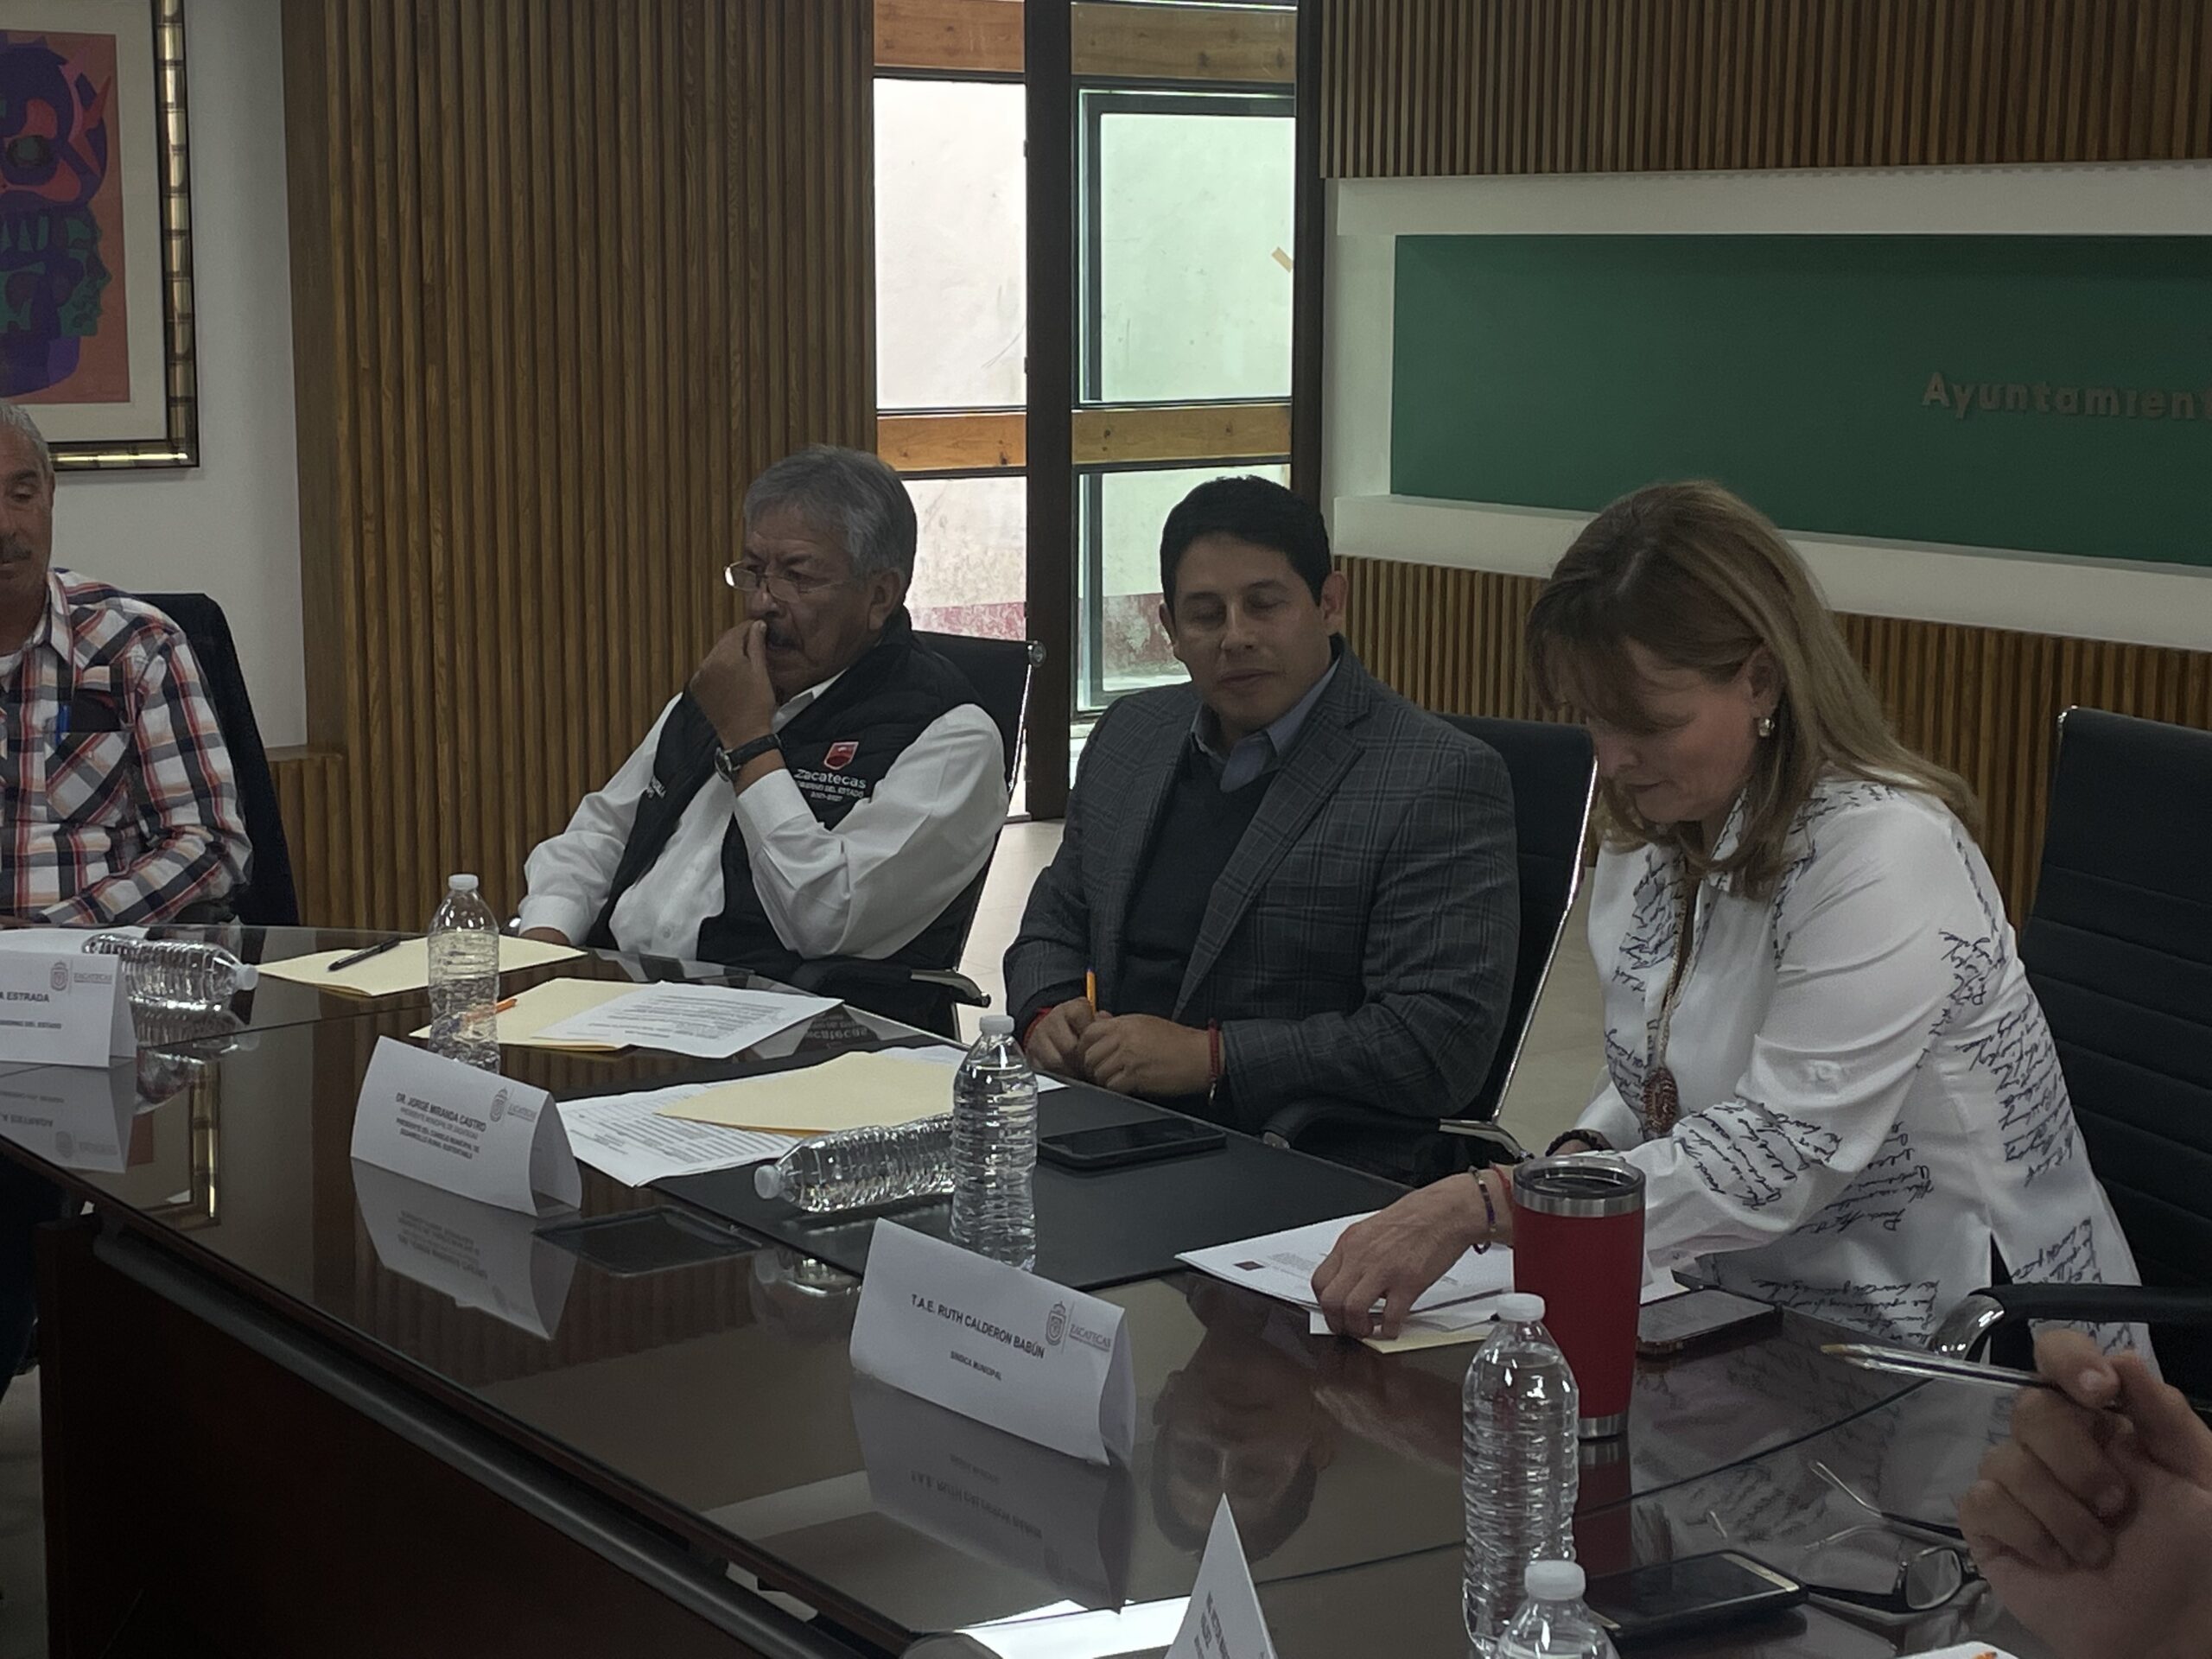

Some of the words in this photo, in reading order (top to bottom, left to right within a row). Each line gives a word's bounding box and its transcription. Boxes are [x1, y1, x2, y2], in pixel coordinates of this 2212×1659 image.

[7, 992, 50, 1002] ESTRADA
[396, 1092, 407, 1104] DR.
[408, 1097, 429, 1112] JORGE
[429, 1104, 459, 1122] MIRANDA
[458, 1115, 487, 1133] CASTRO
[912, 1294, 935, 1314] T.A.E.
[938, 1305, 963, 1324] RUTH
[965, 1315, 1012, 1344] CALDERON
[1014, 1335, 1045, 1359] BABÚN
[1070, 1323, 1111, 1347] ZACATECAS
